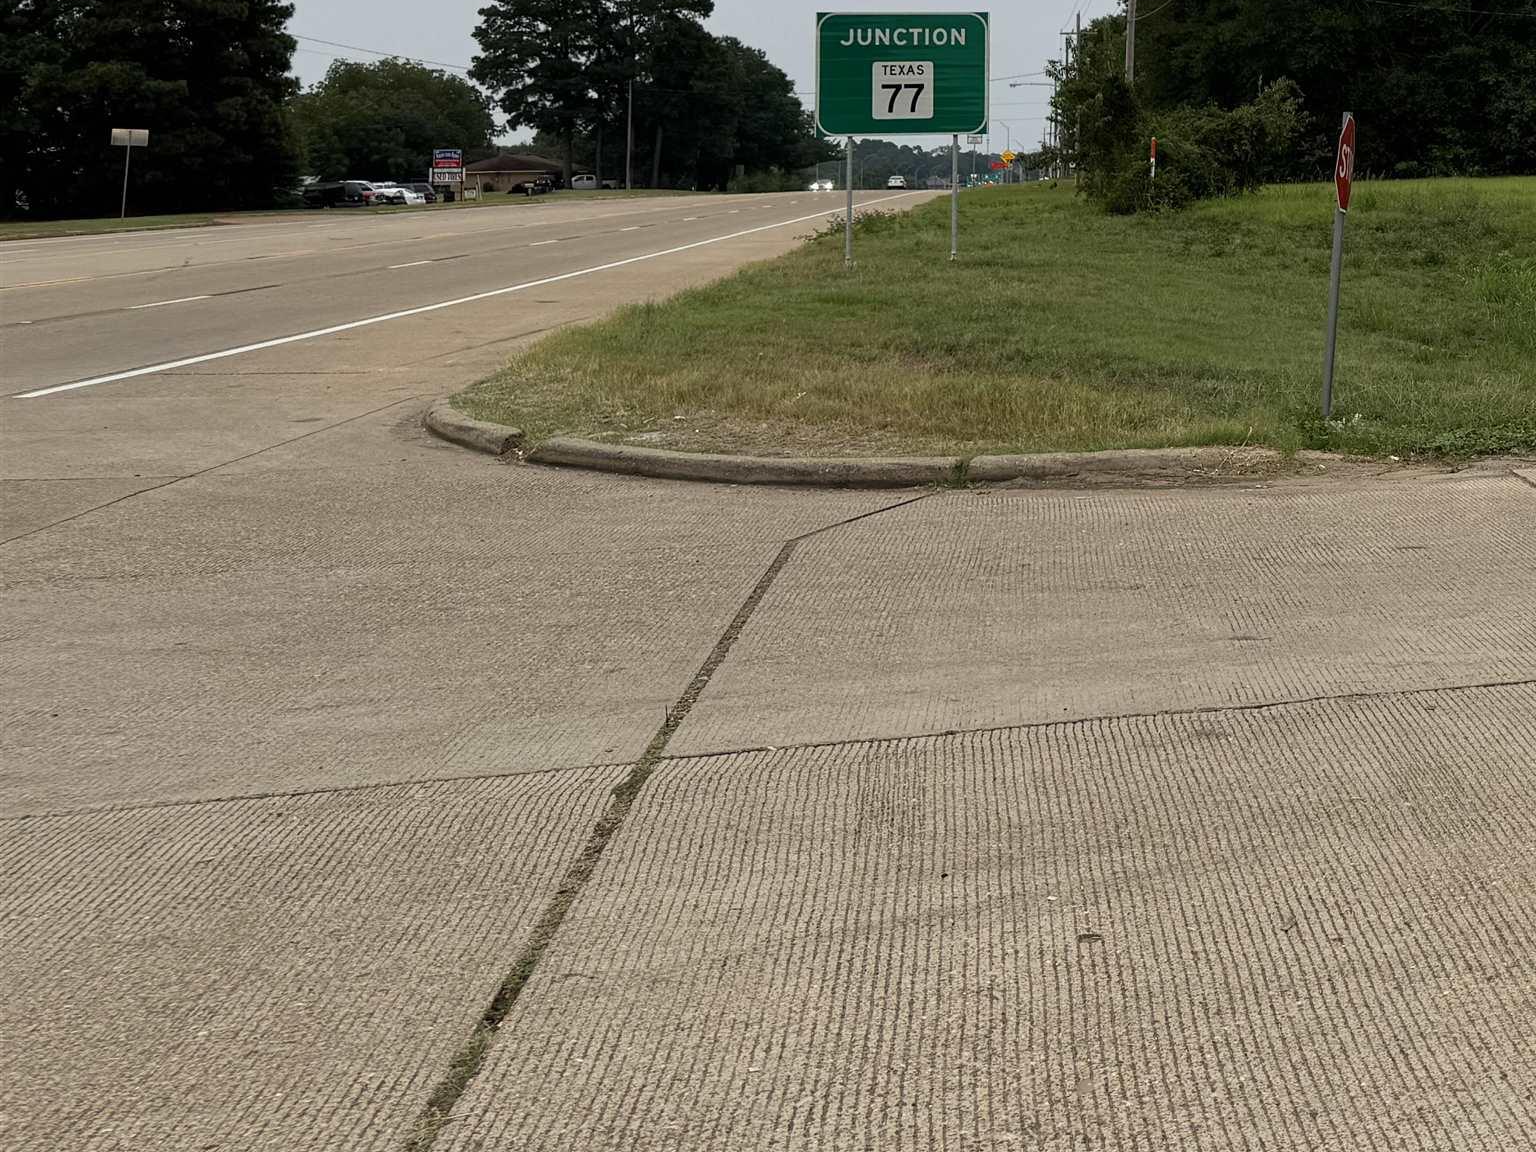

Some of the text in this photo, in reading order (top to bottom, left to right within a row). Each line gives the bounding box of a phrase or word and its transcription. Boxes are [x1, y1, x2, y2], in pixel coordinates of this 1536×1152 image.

[840, 27, 966, 46] JUNCTION
[881, 64, 925, 76] TEXAS
[881, 83, 925, 113] 77
[1339, 143, 1354, 183] ST
